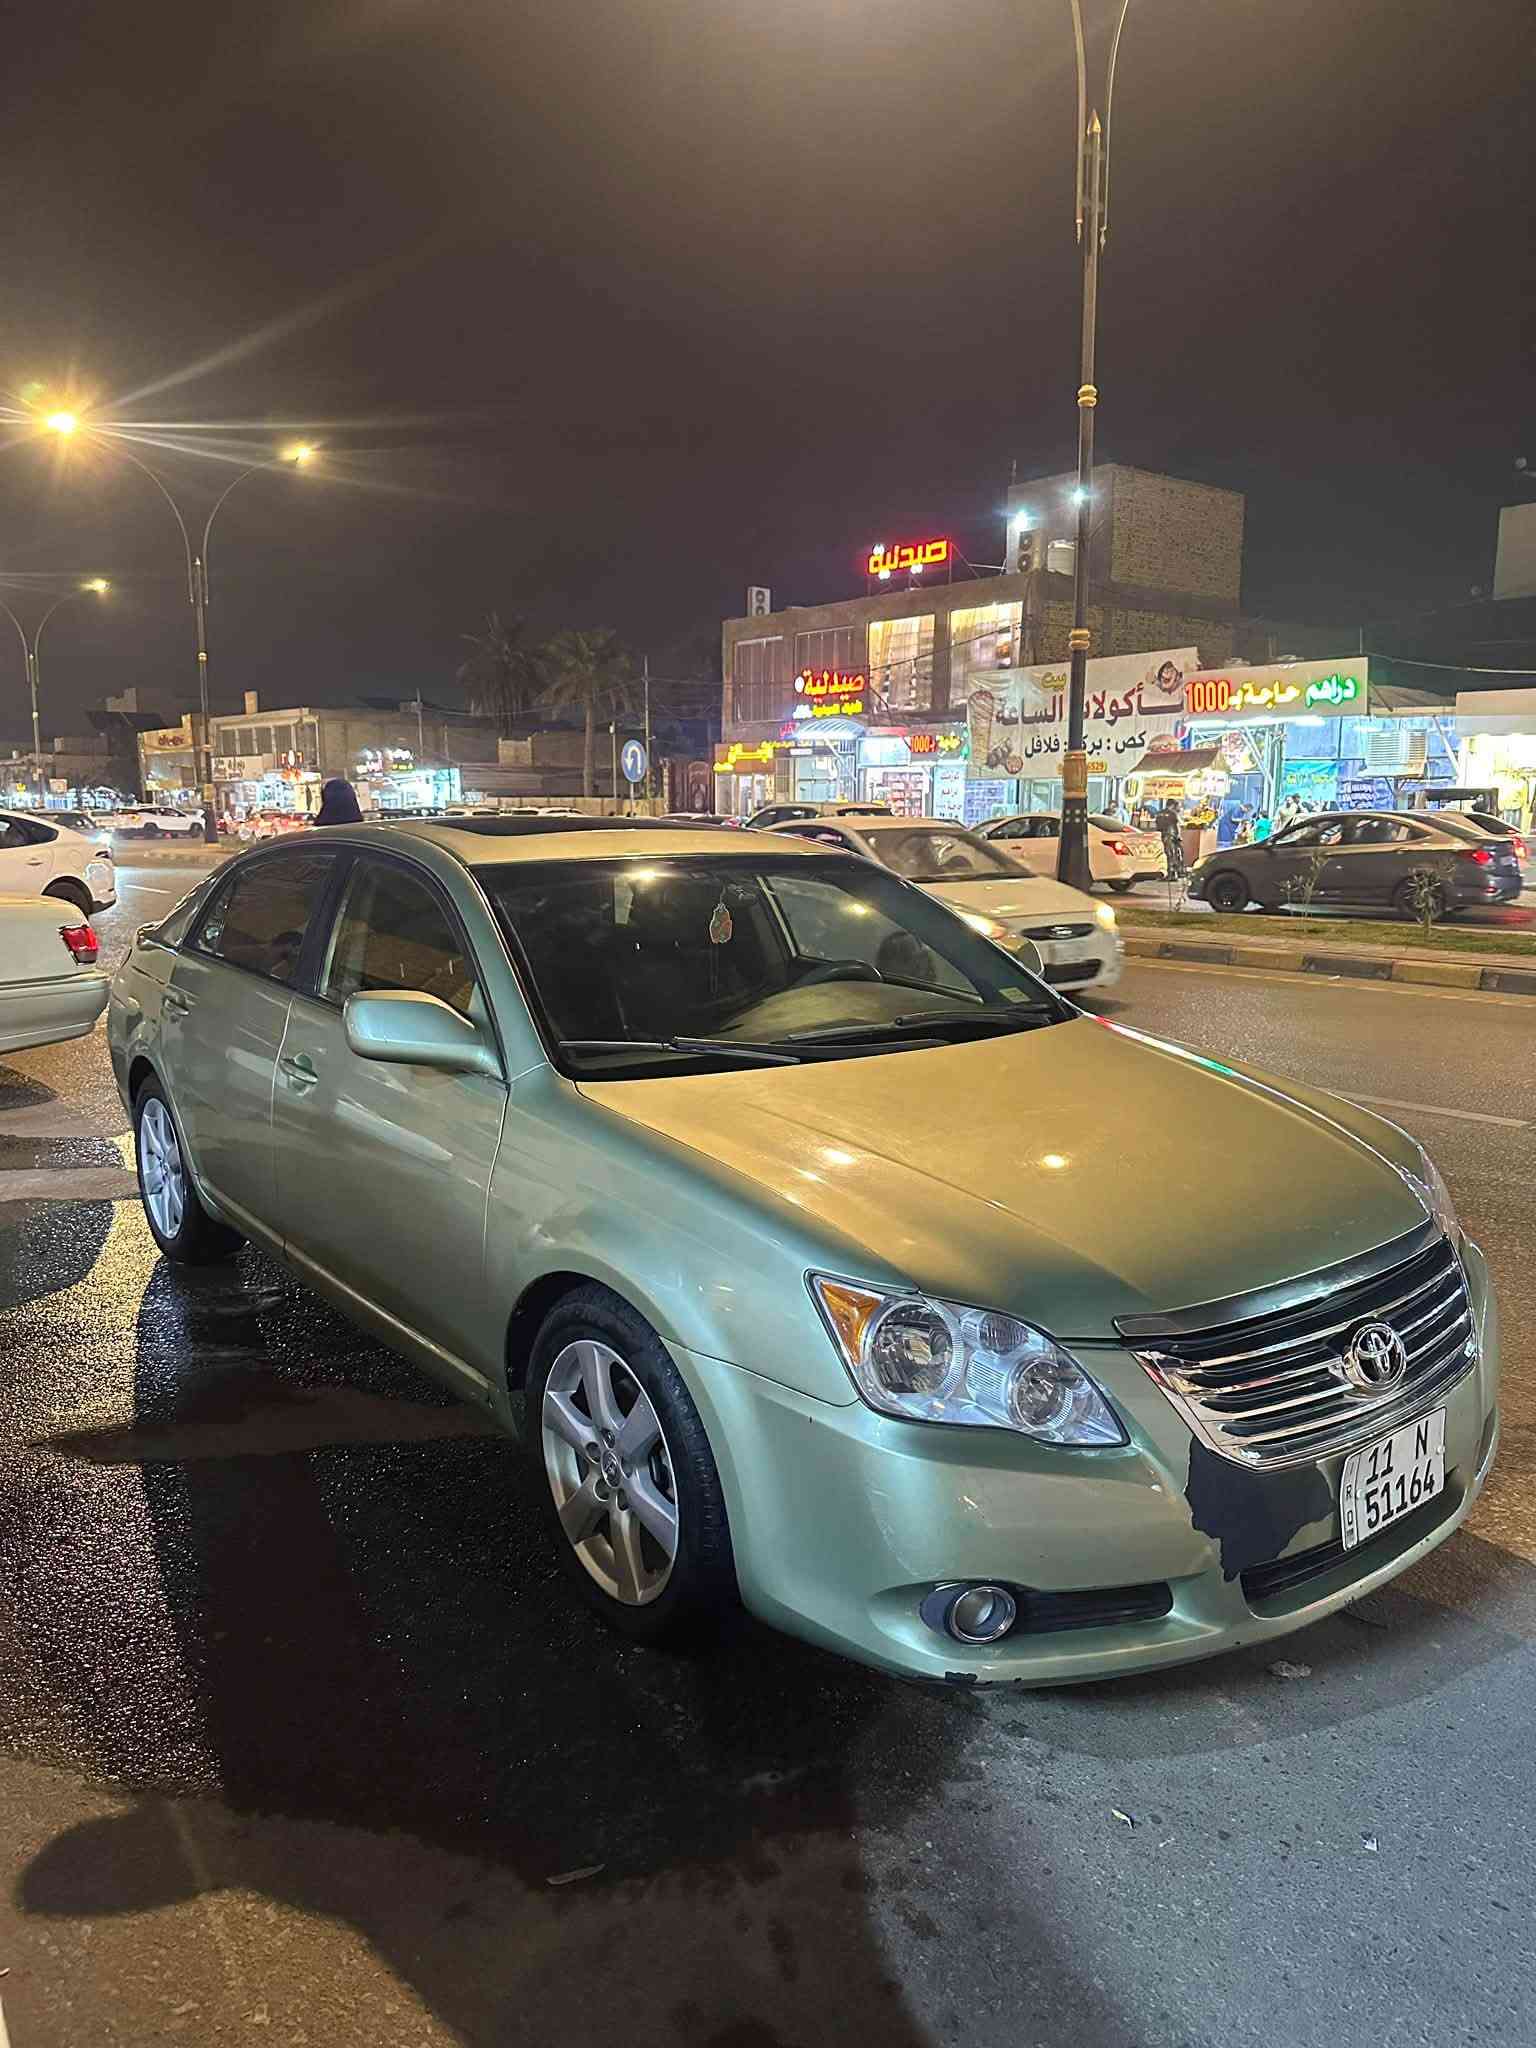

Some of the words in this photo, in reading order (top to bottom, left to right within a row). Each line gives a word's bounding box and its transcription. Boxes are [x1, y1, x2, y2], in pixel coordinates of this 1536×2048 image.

[868, 539, 948, 580] صيدلية
[803, 669, 865, 703] صيدلية
[1243, 680, 1301, 709] حاجة
[1305, 673, 1357, 708] دراهم
[996, 694, 1063, 726] الساعة
[1024, 734, 1060, 758] فلافل
[1115, 730, 1146, 754] كص
[1366, 1439, 1394, 1486] 11
[1415, 1420, 1429, 1460] N
[1365, 1458, 1436, 1530] 51164
